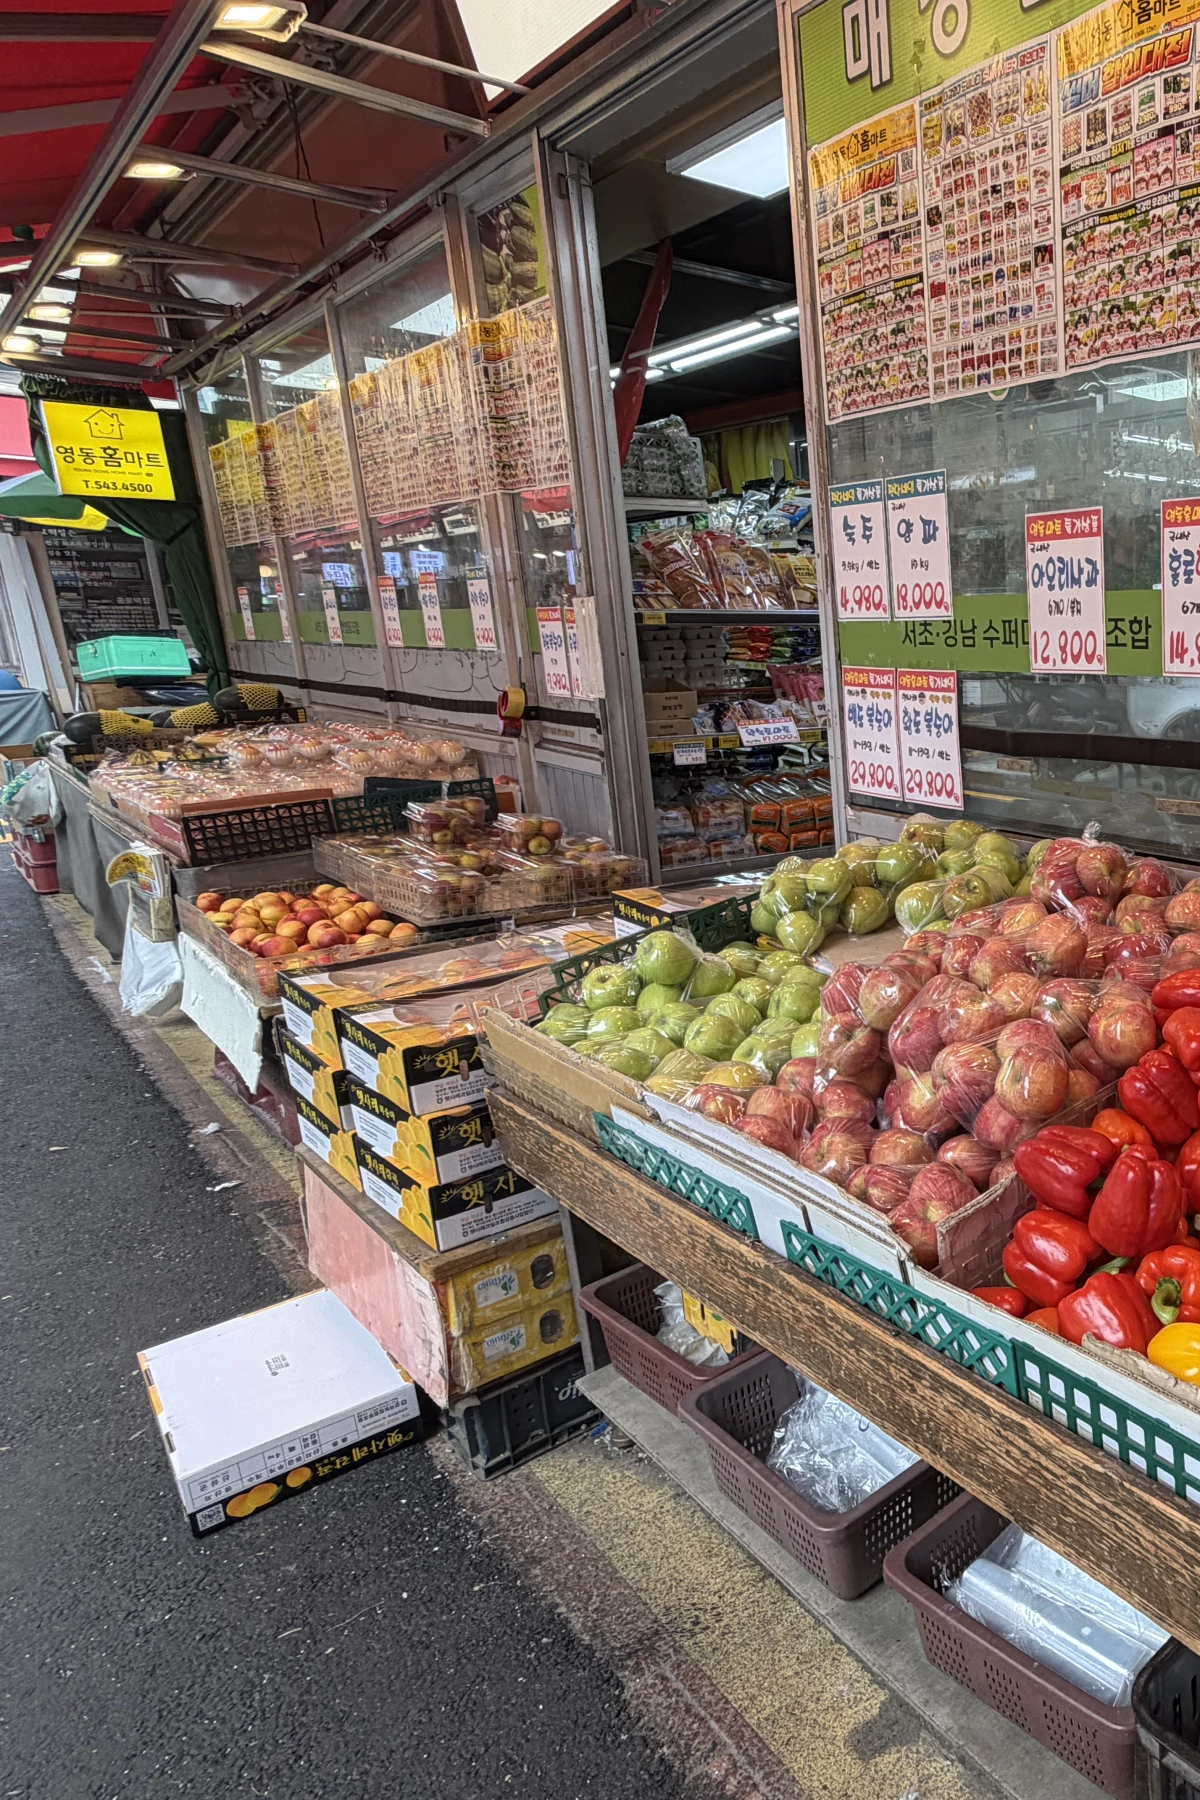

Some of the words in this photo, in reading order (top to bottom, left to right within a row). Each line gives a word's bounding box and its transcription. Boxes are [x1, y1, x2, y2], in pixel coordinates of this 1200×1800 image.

[55, 445, 165, 468] 영동홈마트
[82, 479, 153, 493] T.543.4500
[1168, 530, 1191, 542] 국내산
[1031, 556, 1100, 592] 아오리사과
